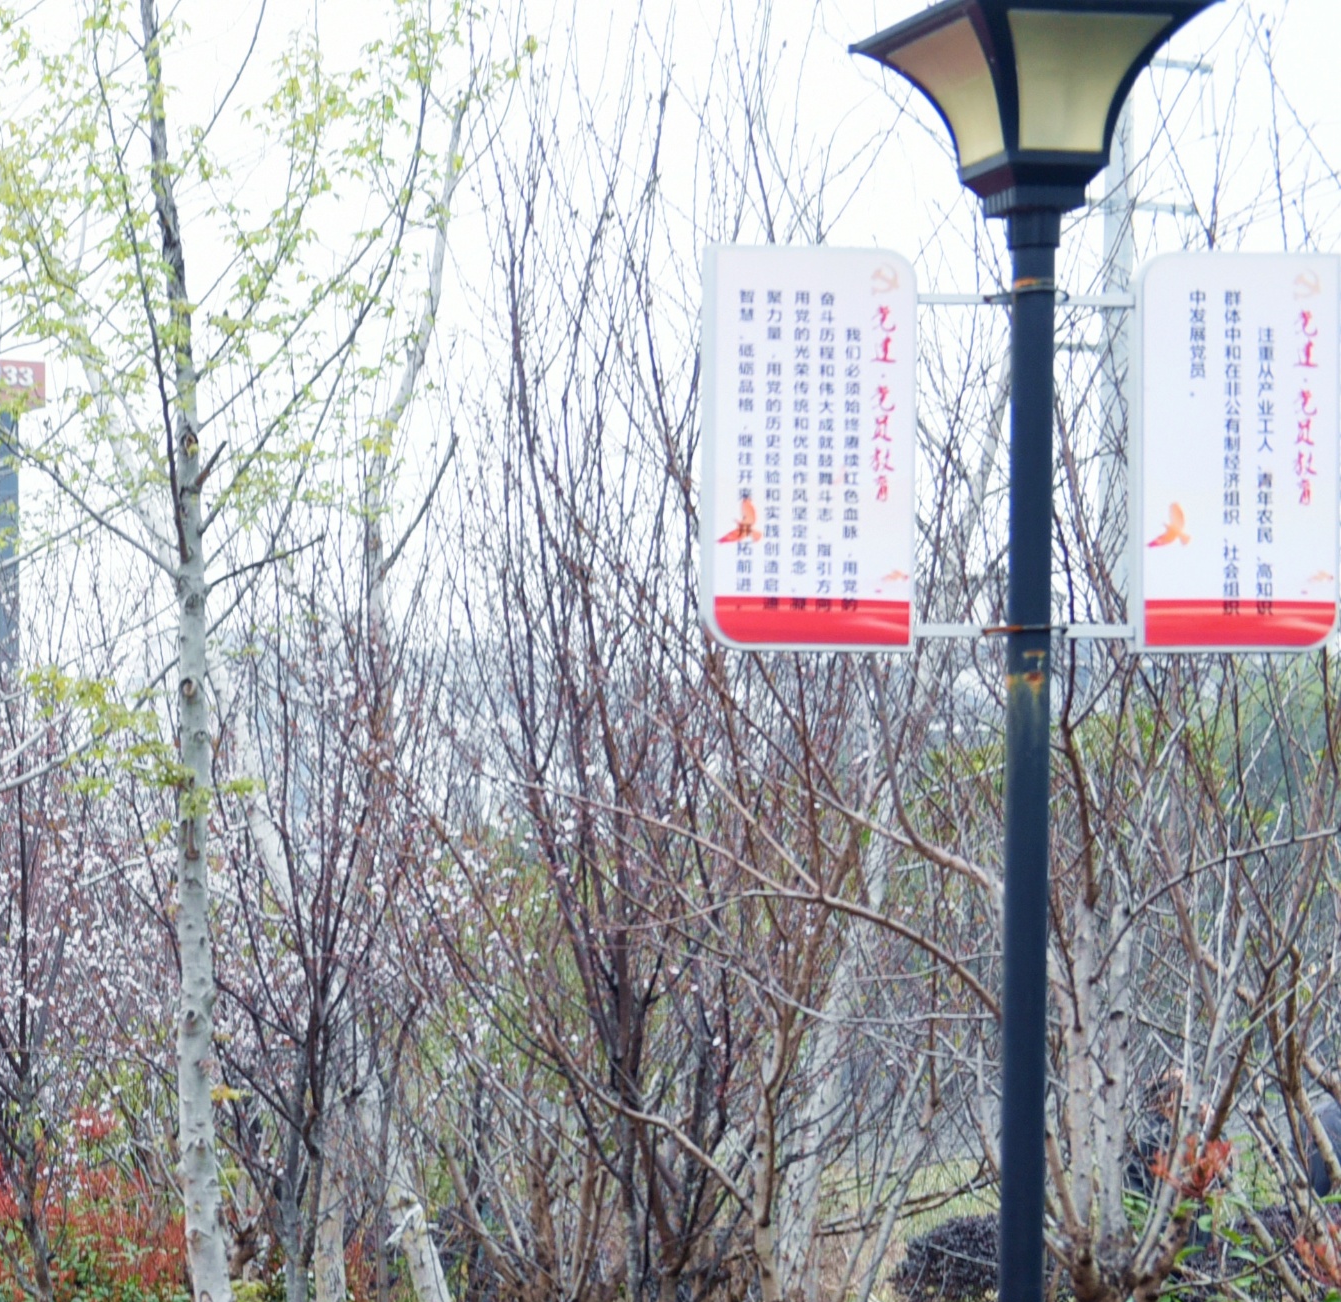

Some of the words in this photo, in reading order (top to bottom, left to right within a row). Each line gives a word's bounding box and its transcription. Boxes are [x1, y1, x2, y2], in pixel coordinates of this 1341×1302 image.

[1189, 288, 1206, 397] 中发展党员。
